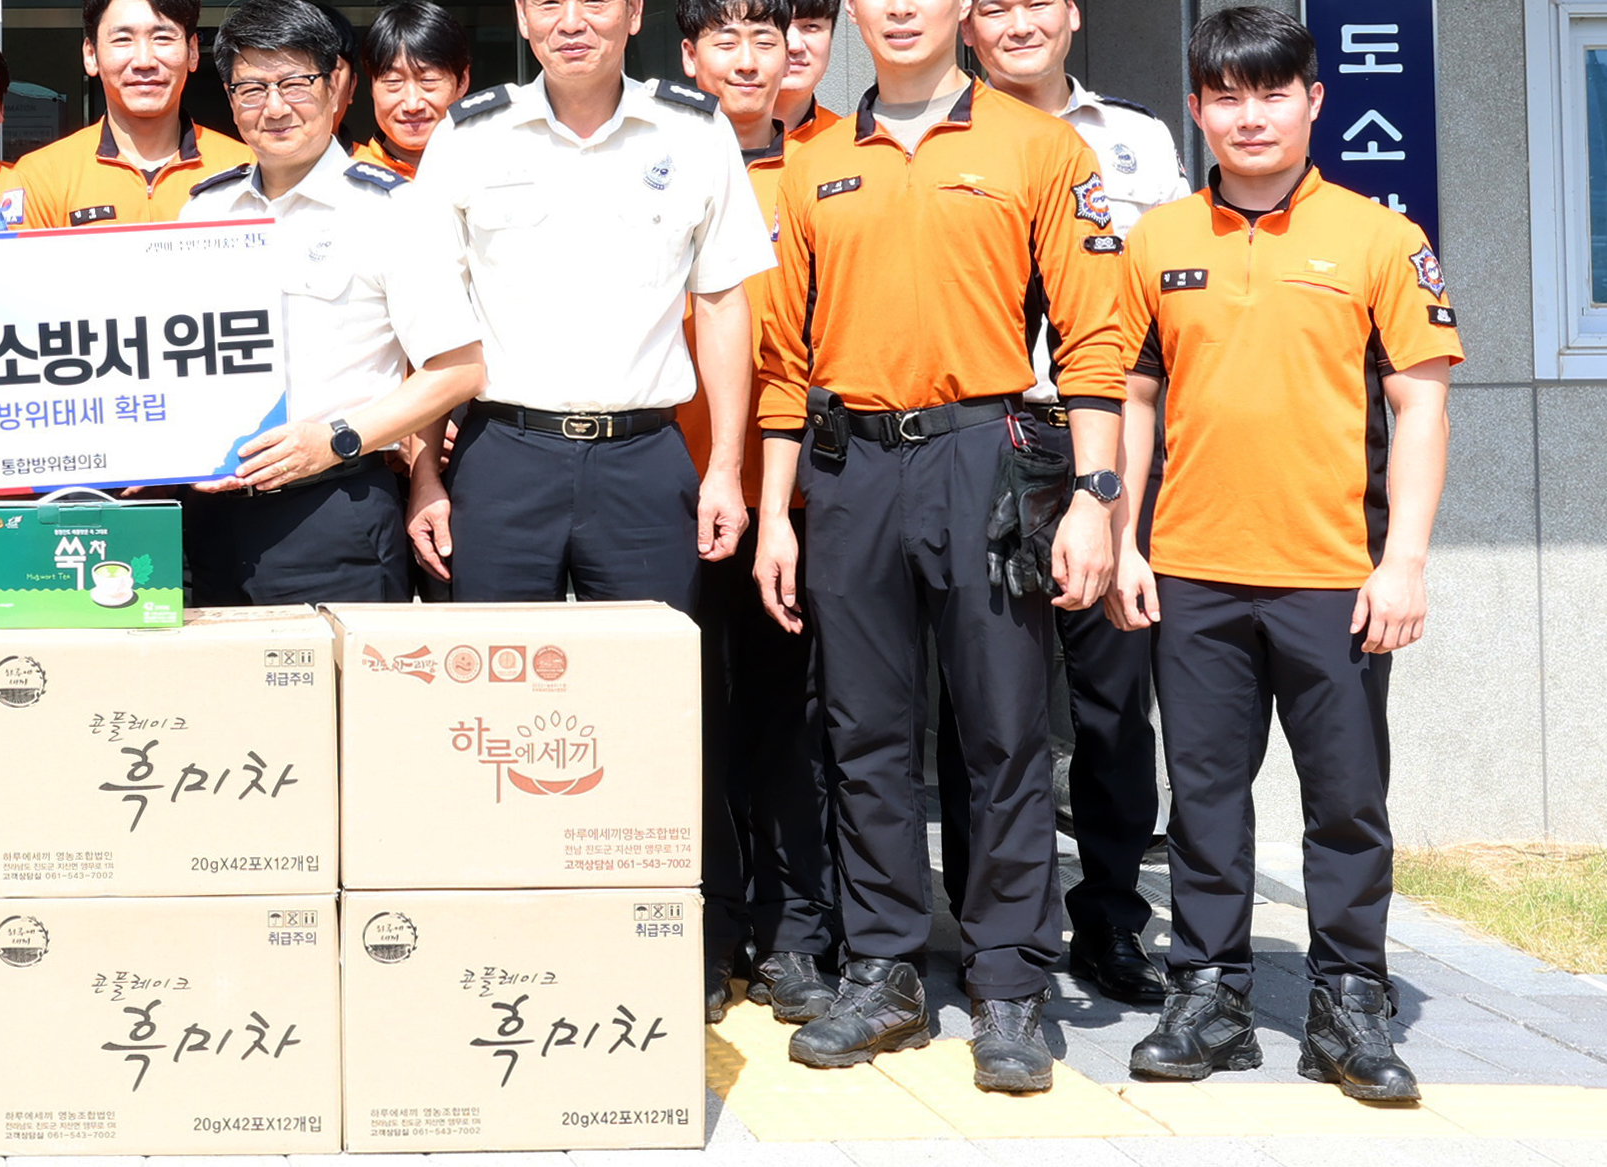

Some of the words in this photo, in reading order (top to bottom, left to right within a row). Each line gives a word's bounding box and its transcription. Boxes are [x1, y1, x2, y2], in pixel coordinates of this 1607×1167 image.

[245, 232, 269, 248] 진도
[163, 309, 274, 377] 위문
[114, 393, 167, 424] 확립
[1, 453, 108, 477] 통합방위협의회
[58, 572, 71, 580] Tea
[264, 671, 314, 686] 취급주의
[449, 717, 597, 804] 하루에세끼
[98, 739, 299, 833] 흑미차
[564, 827, 691, 841] 하루에세끼영농조합법인
[585, 844, 612, 855] 진도군
[675, 844, 691, 855] 174
[564, 859, 614, 871] 고객상담실
[617, 859, 691, 869] 061-543-7002
[268, 931, 318, 946] 취급주의
[635, 923, 684, 938] 취급주의
[101, 999, 301, 1092] 흑미차
[469, 994, 668, 1088] 흑미차
